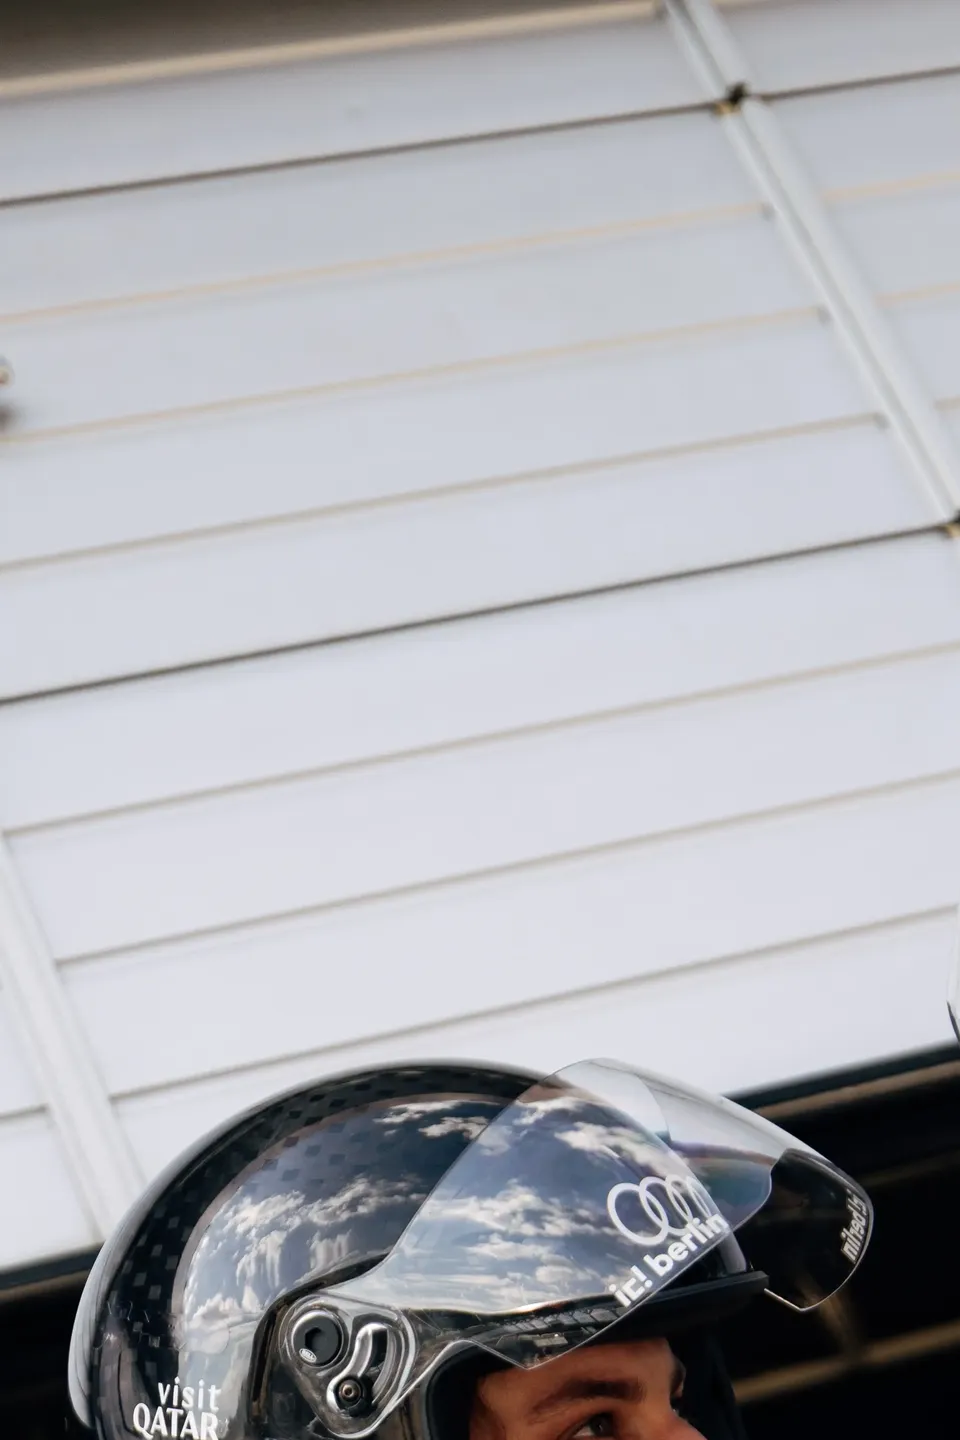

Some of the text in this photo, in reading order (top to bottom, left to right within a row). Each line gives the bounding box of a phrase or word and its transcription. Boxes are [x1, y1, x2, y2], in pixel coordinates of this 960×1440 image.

[608, 1213, 730, 1308] ic! berlin
[157, 1376, 221, 1413] visit
